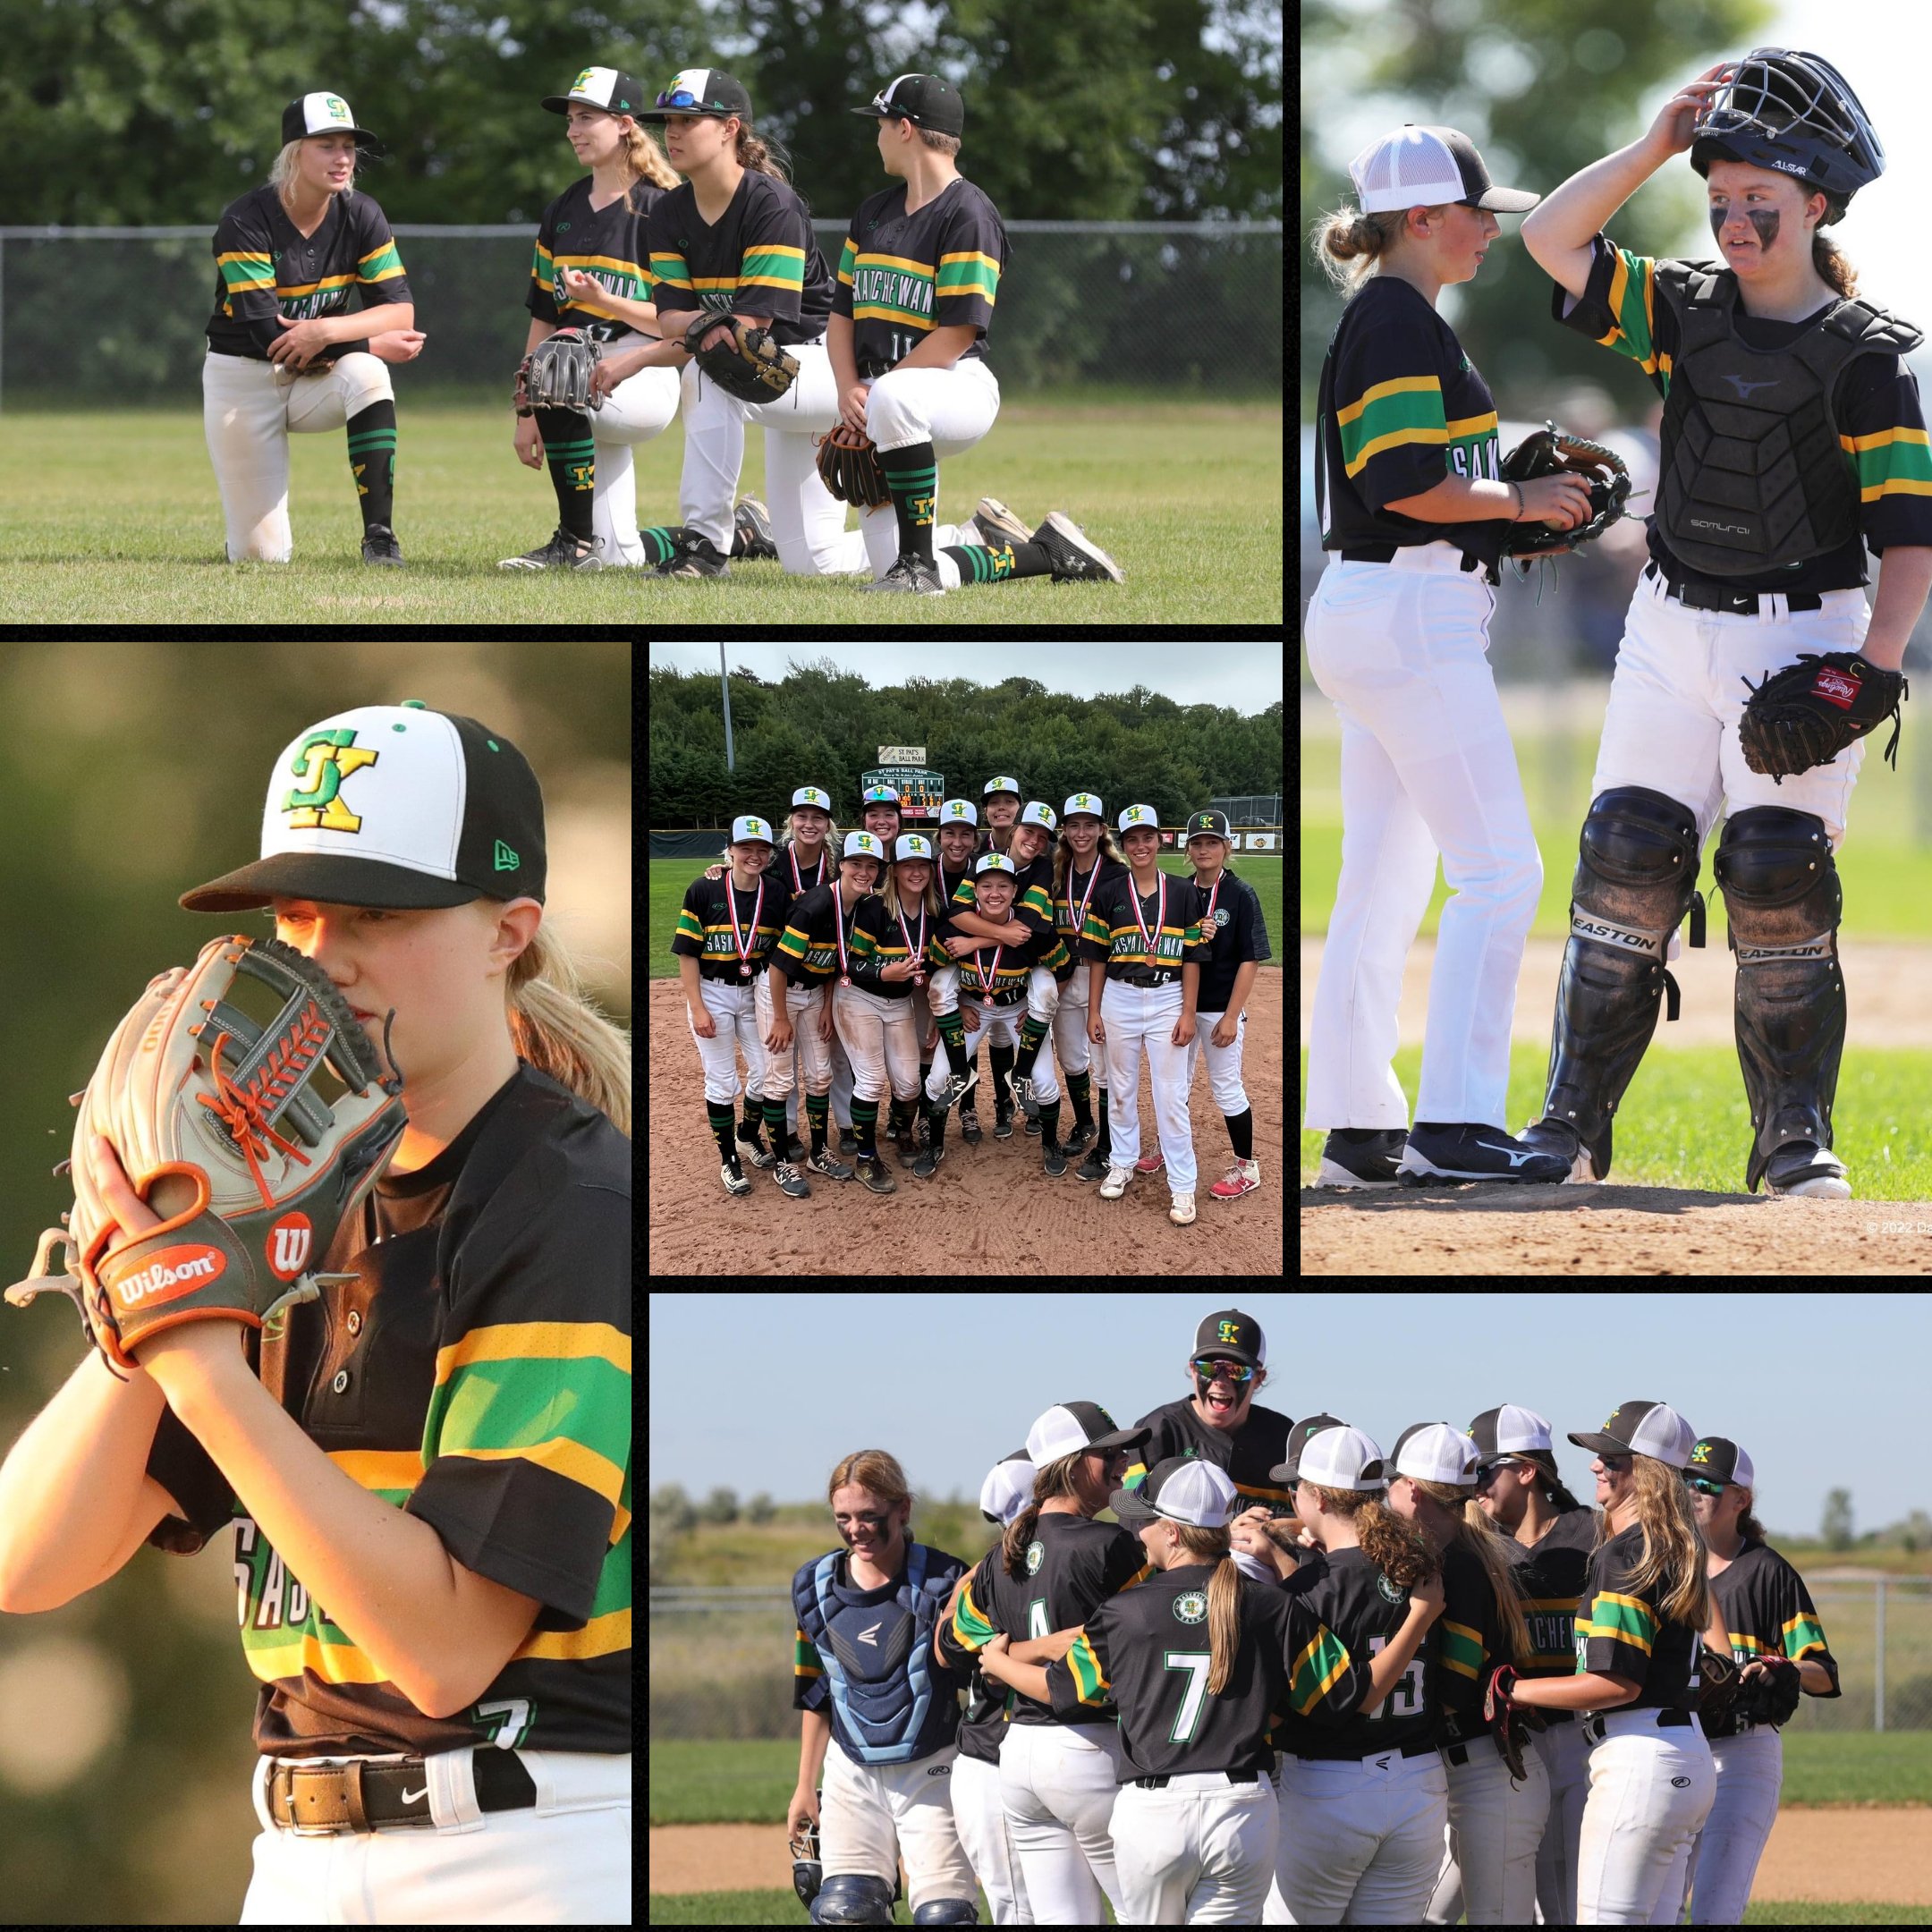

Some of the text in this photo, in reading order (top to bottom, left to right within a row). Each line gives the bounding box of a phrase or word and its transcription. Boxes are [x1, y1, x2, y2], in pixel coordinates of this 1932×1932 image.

[1772, 160, 1807, 176] ALL-STAR
[852, 269, 934, 314] KATCHEWAN
[892, 334, 912, 360] 11
[1453, 438, 1500, 480] SAK
[281, 728, 380, 835] SK
[1572, 918, 1657, 951] EASTON
[275, 1228, 310, 1272] W
[116, 1255, 215, 1306] Wilson
[1165, 1652, 1211, 1742] 7
[474, 1697, 534, 1750] 7
